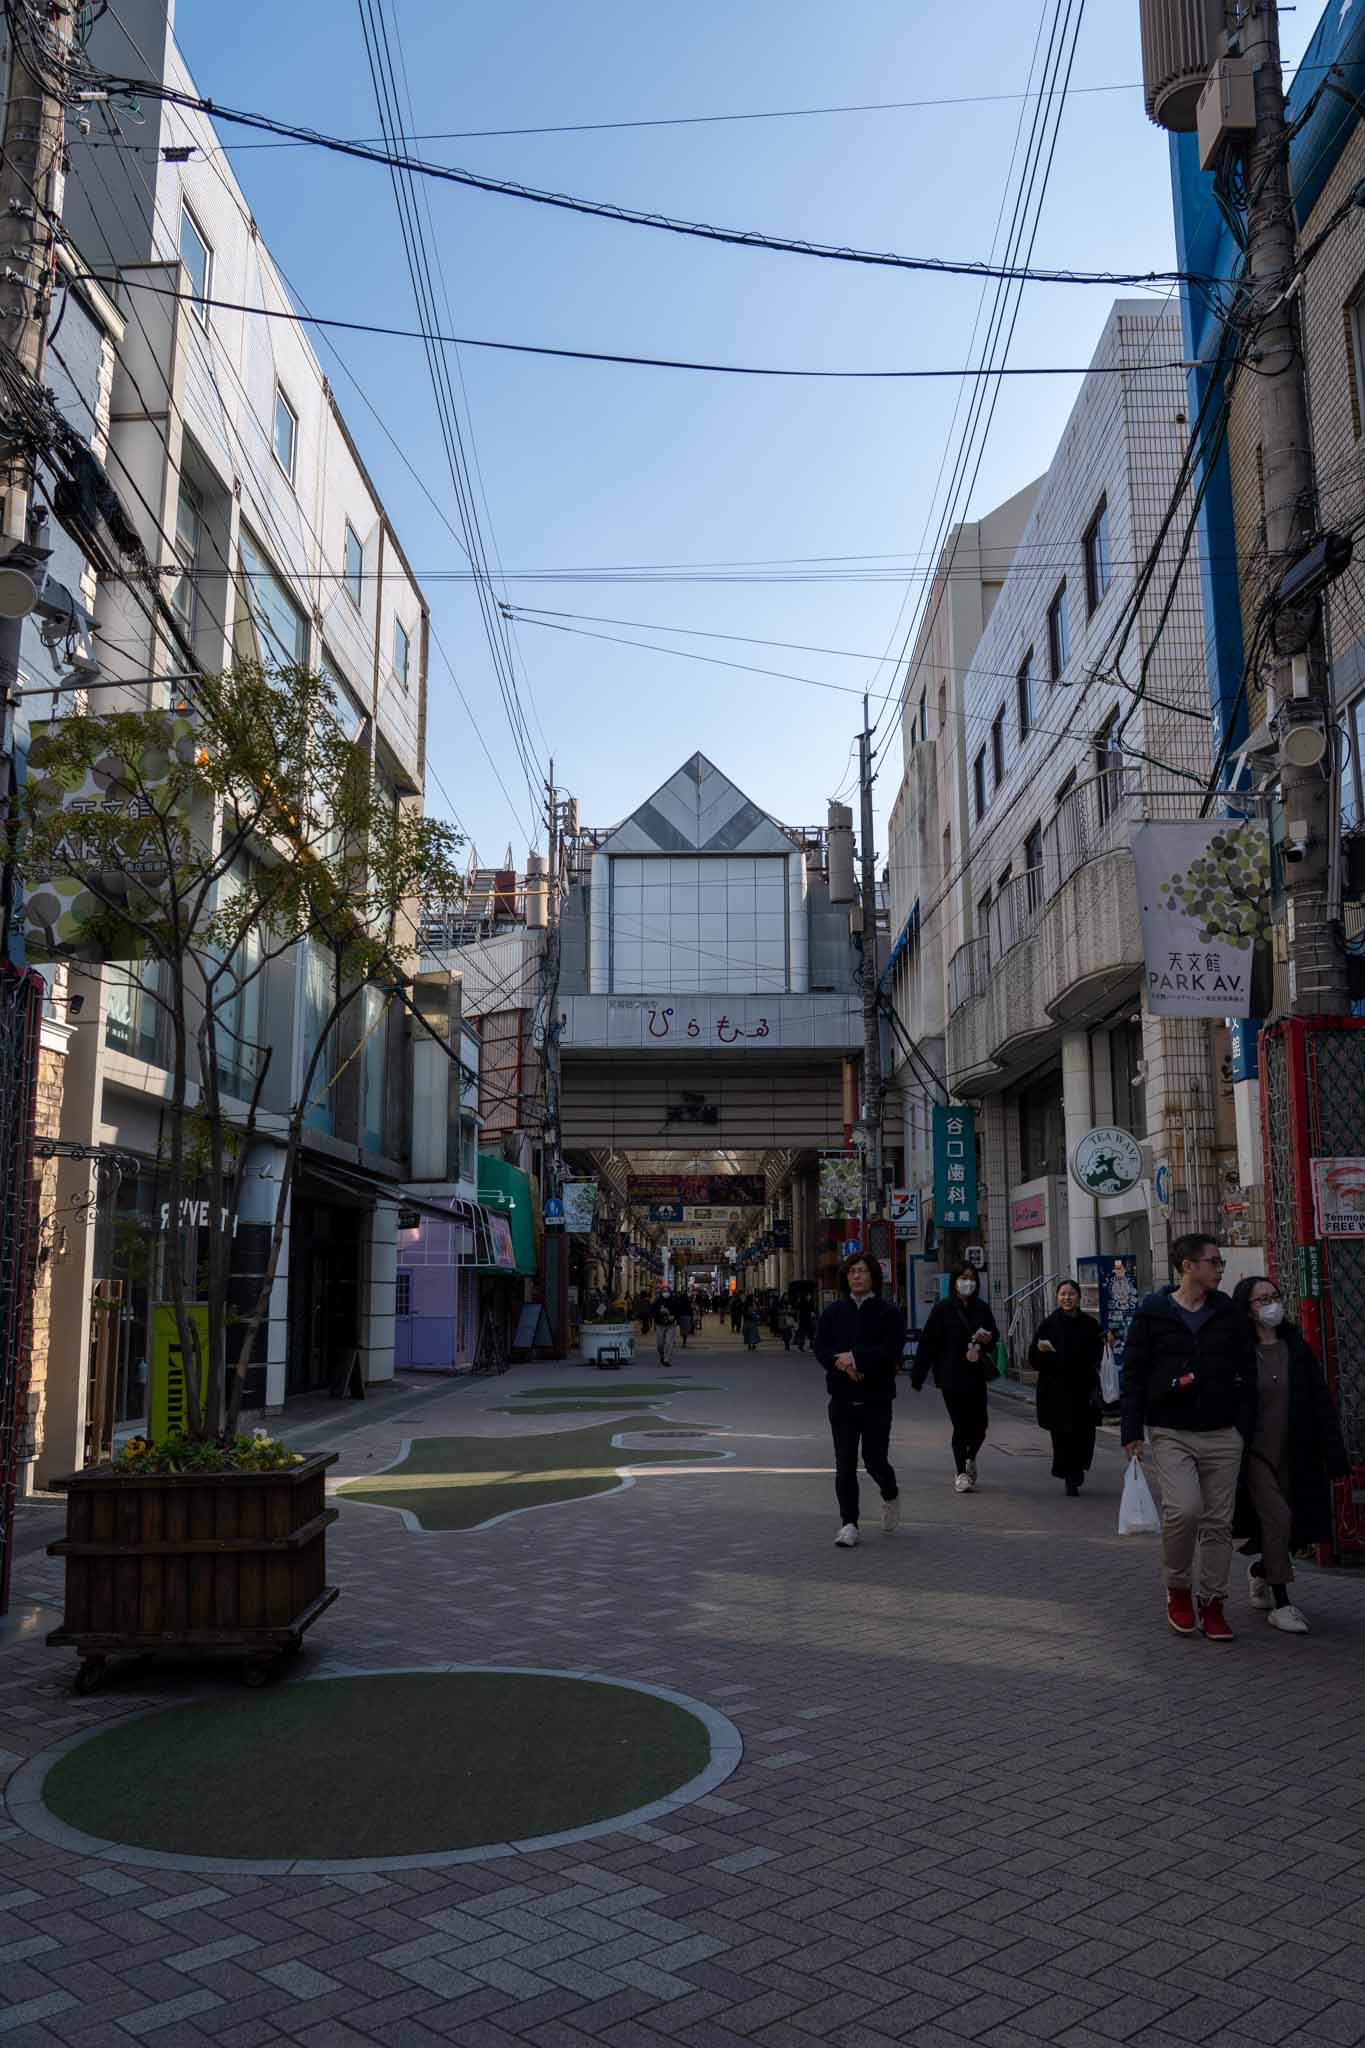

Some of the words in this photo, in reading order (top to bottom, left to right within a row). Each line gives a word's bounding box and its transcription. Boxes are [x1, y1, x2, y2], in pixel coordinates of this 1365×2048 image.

[1168, 952, 1221, 972] 天文館
[1149, 972, 1205, 991] PARK
[1213, 975, 1244, 992] AV.
[946, 1117, 966, 1205] 谷口歯科
[1326, 1223, 1356, 1231] FREE
